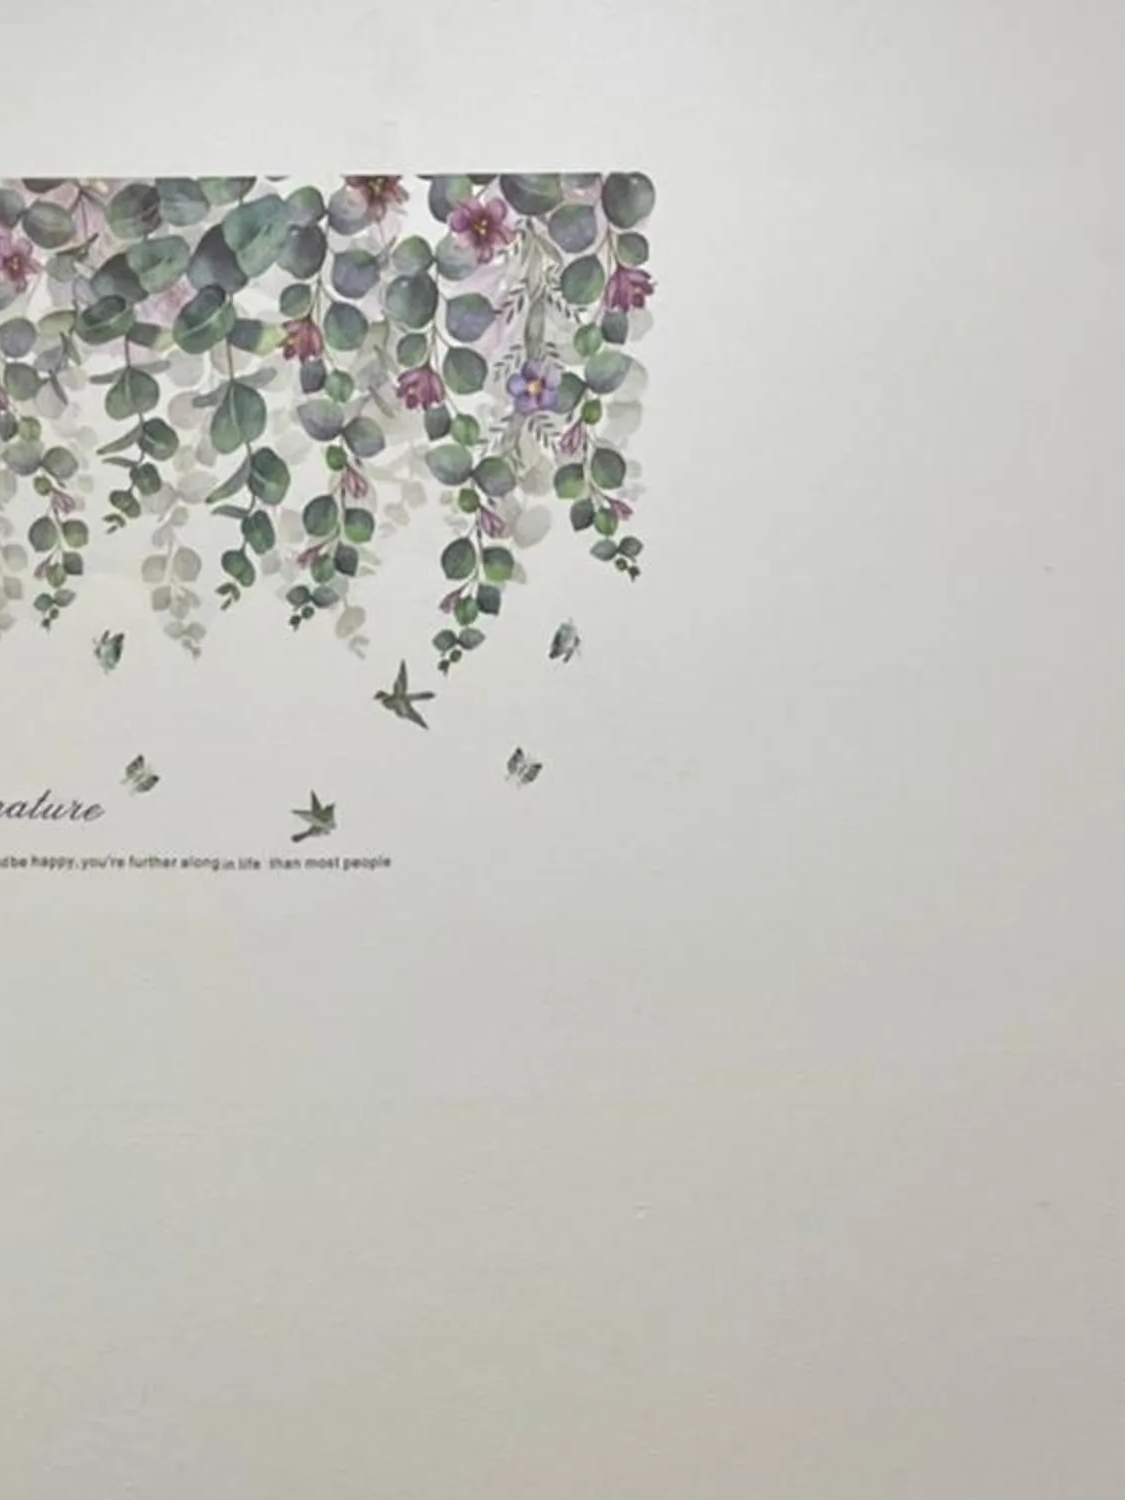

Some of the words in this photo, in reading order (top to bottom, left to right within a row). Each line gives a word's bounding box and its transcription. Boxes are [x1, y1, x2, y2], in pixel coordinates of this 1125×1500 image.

[80, 854, 126, 872] you're
[128, 854, 177, 870] further
[180, 855, 221, 873] along
[237, 856, 262, 871] life
[268, 857, 302, 871] than
[304, 856, 340, 870] most
[342, 855, 392, 872] people
